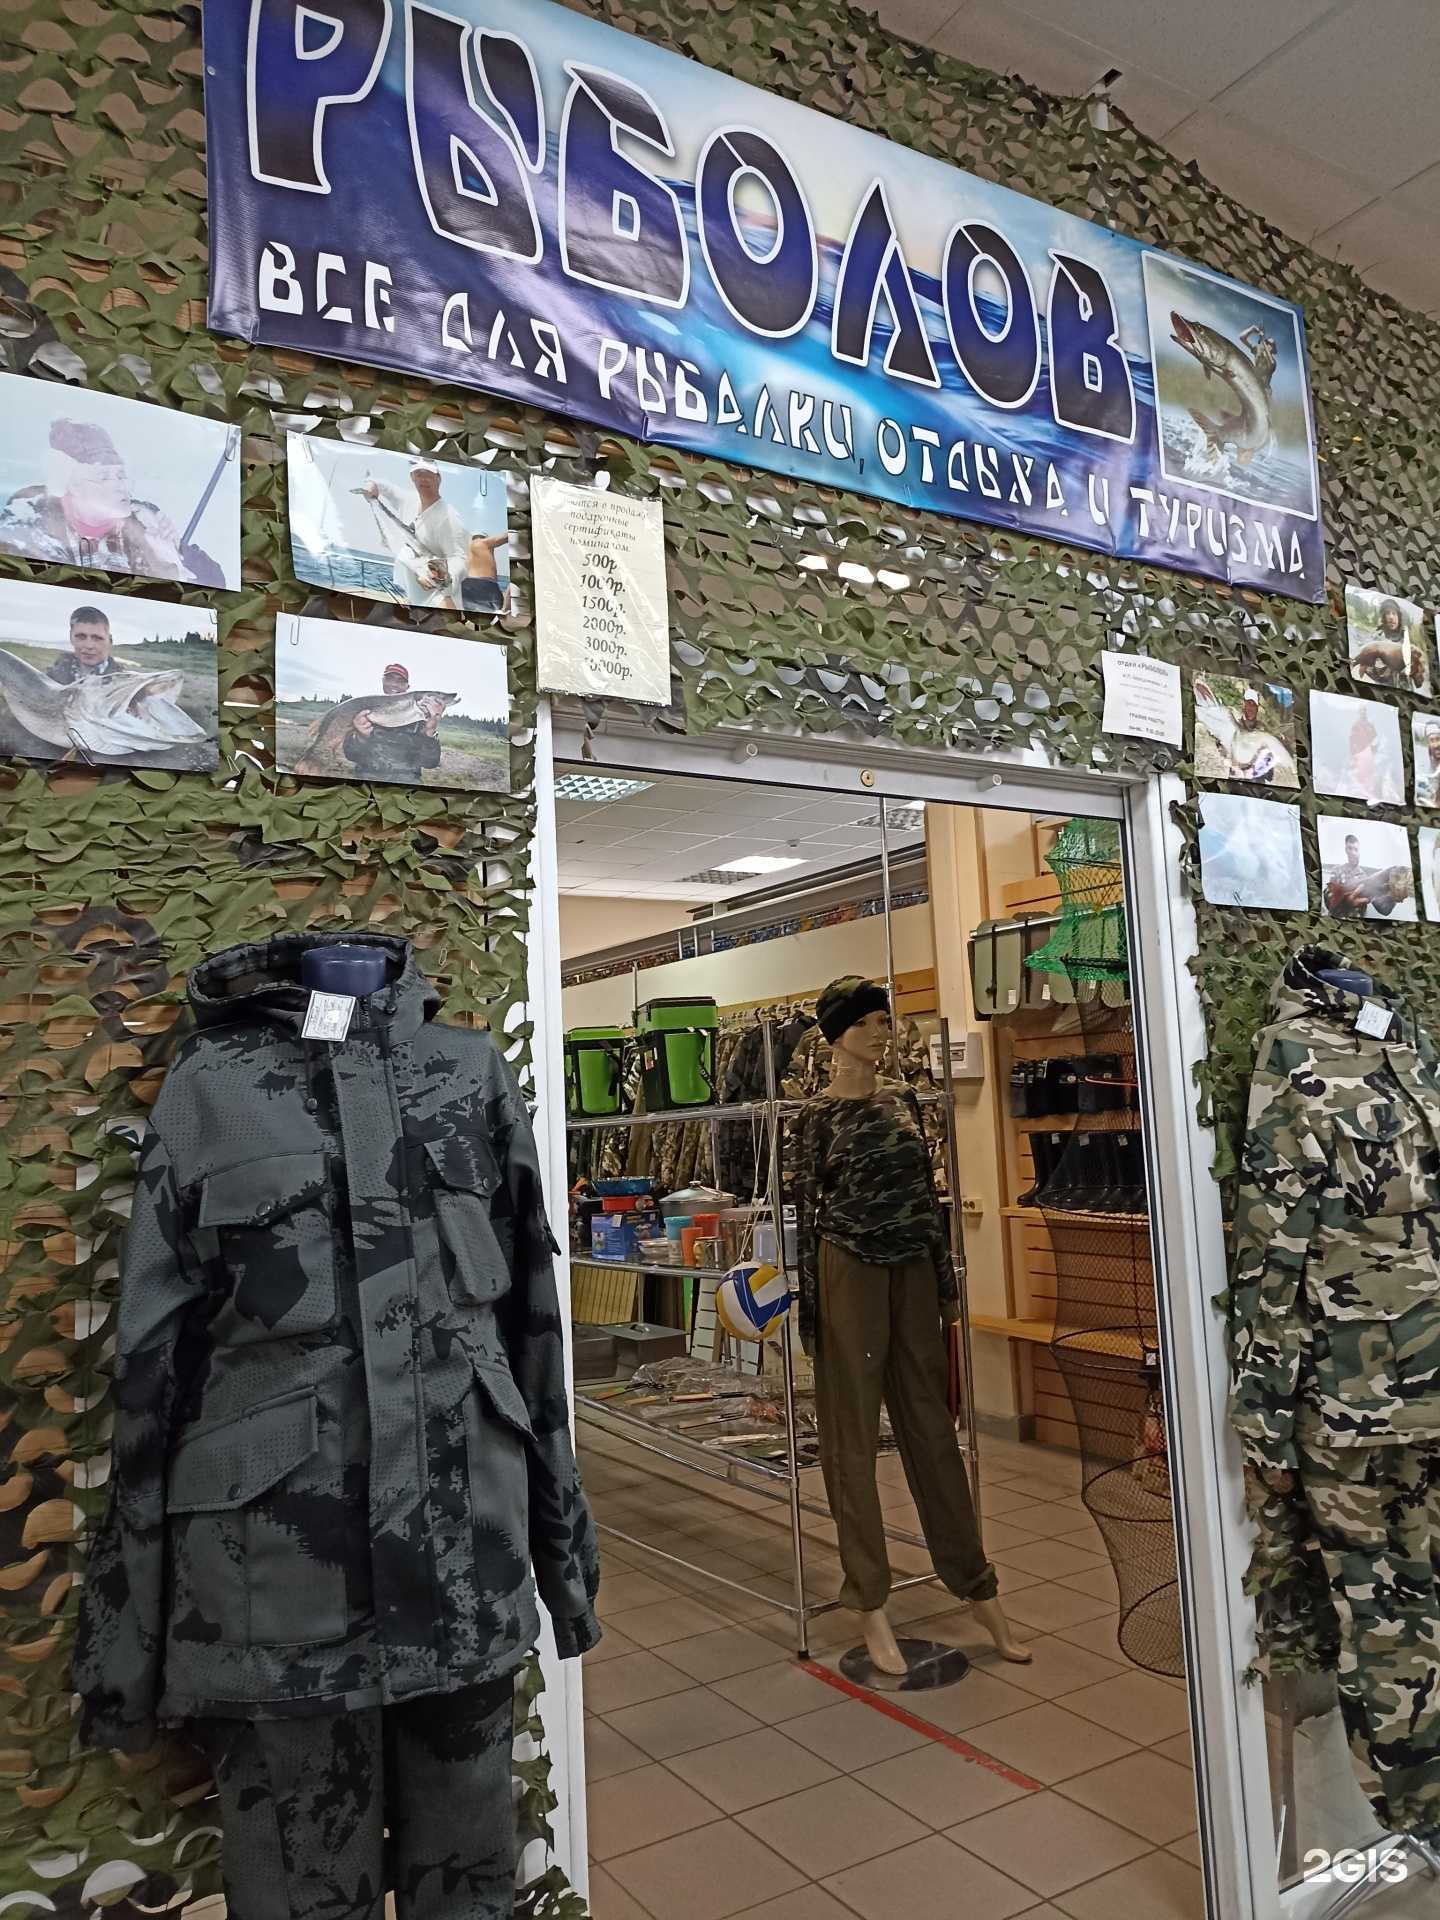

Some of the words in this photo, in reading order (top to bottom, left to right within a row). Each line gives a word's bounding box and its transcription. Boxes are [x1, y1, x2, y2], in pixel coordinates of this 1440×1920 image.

[248, 0, 1136, 444] РЫБОЛОВ
[258, 241, 395, 332] ВСЕ
[442, 293, 567, 384] ДЛЯ
[598, 338, 864, 474] РЫБАЛКИ,
[876, 417, 1068, 517] ОТДЫХА
[1088, 473, 1111, 526] И
[1130, 486, 1306, 579] ТУРИЗМА
[583, 615, 626, 639] 2000р.
[584, 636, 627, 660] 3000р.
